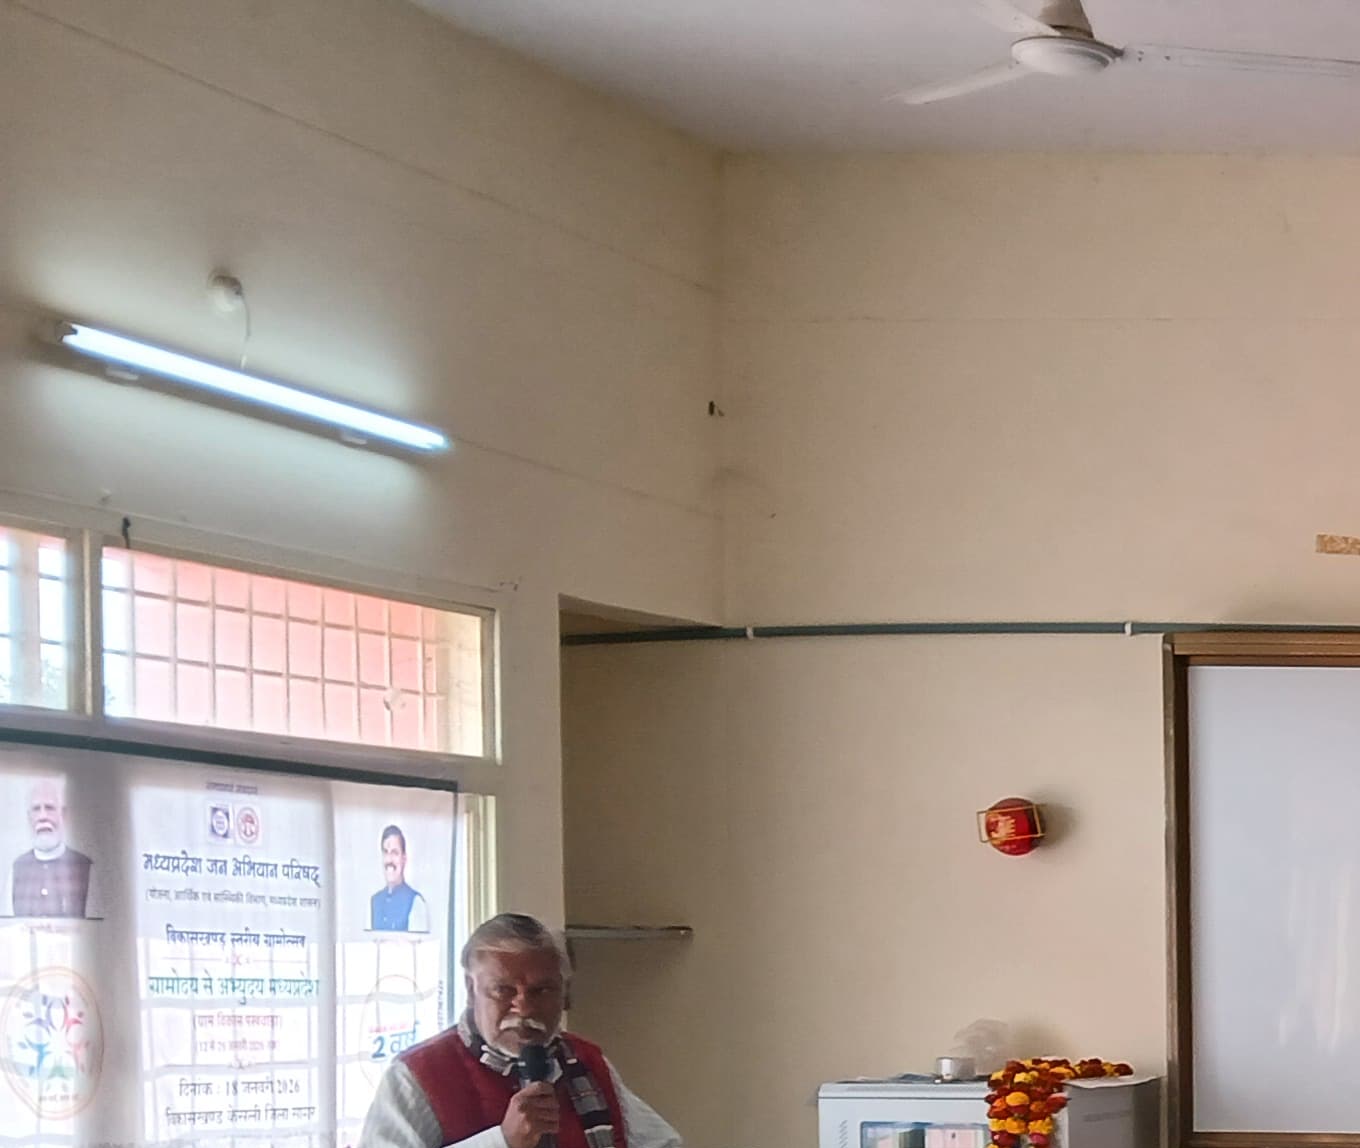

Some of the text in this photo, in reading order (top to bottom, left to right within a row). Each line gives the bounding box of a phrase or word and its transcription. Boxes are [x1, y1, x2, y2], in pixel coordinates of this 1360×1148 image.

[206, 858, 228, 876] जन
[371, 1035, 387, 1059] 2
[225, 1079, 239, 1096] 18
